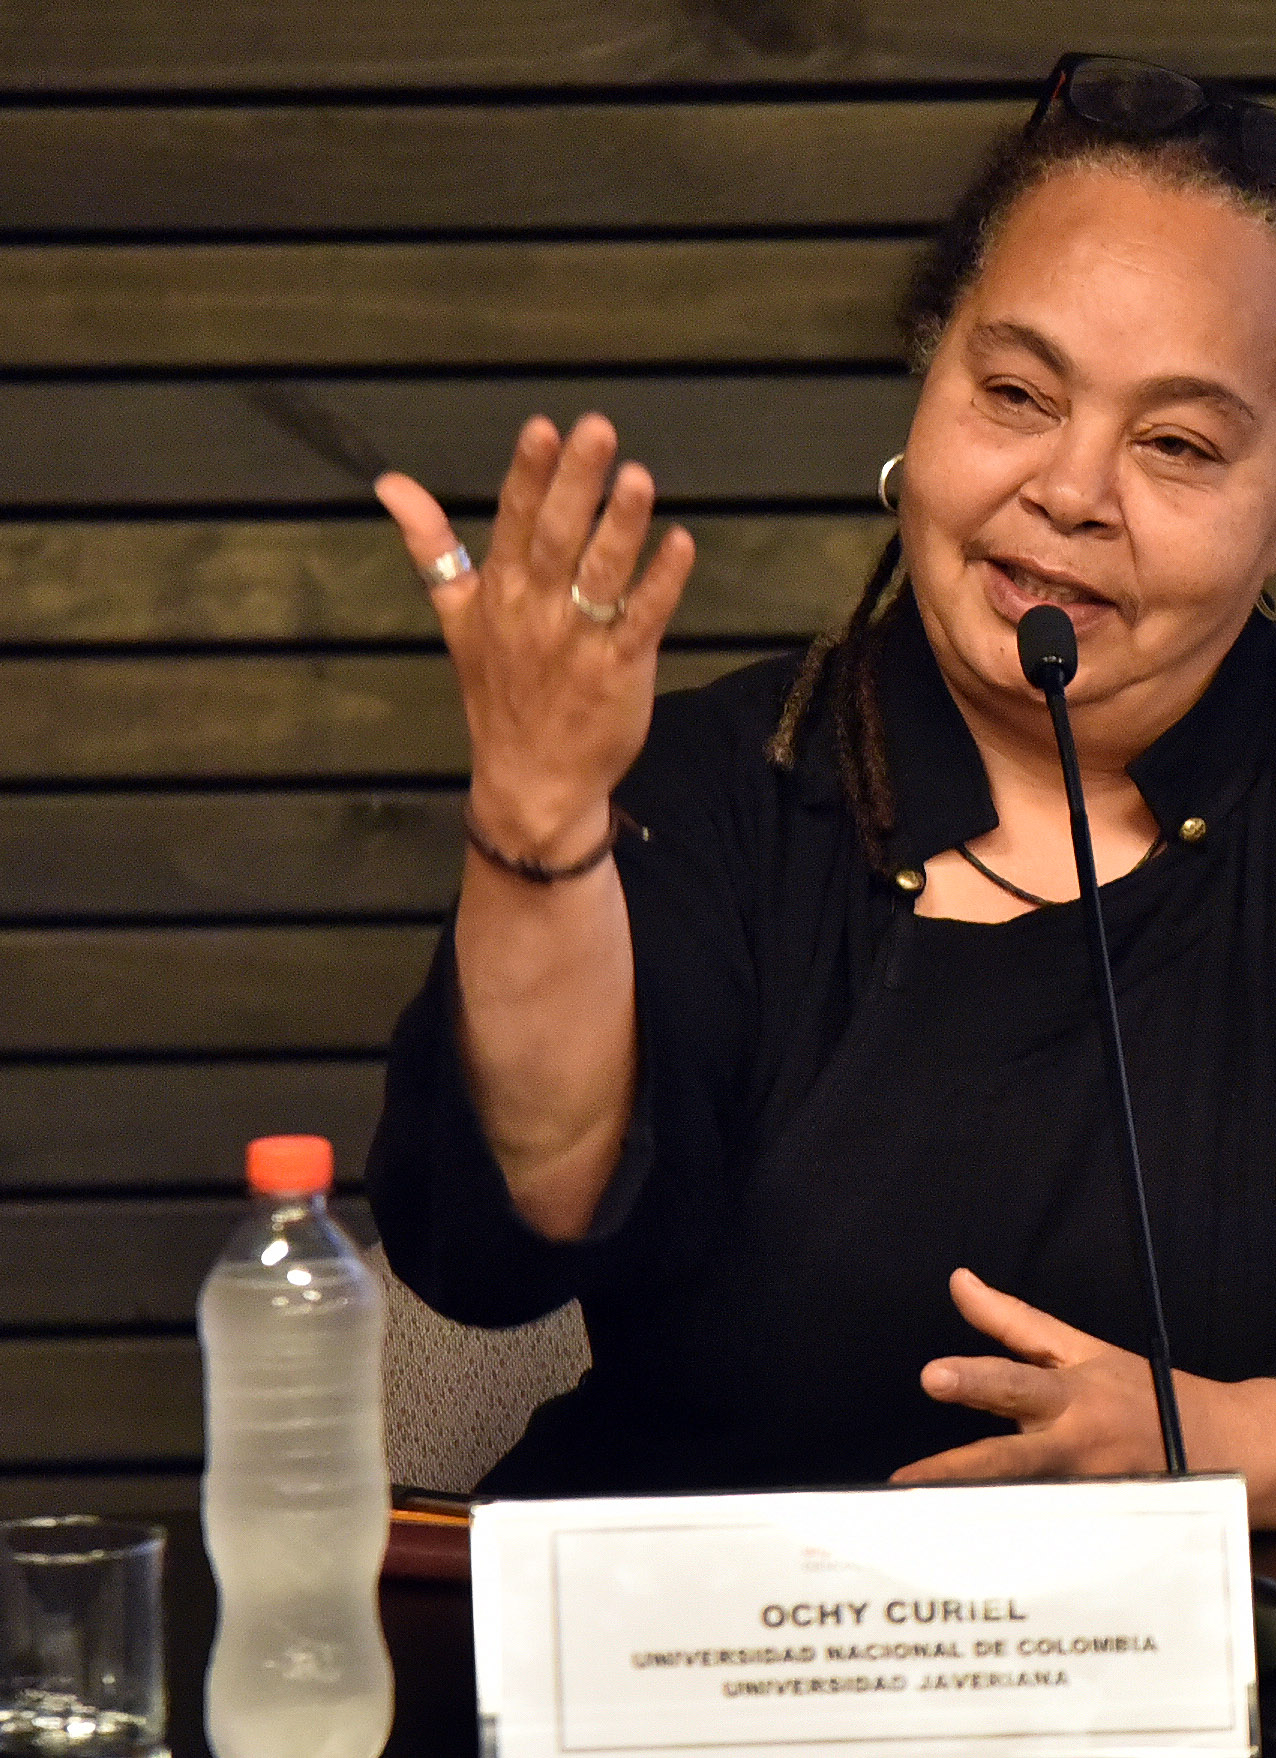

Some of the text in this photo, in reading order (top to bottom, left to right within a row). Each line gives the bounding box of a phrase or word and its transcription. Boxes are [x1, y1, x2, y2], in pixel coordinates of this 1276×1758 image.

[762, 1599, 1026, 1627] OCHY CURIEL
[631, 1636, 1157, 1667] UNIVERSIDAD NACIONAL DE COLOMBIA
[723, 1671, 1068, 1697] UNIVERSIDAD JAVERIANA
